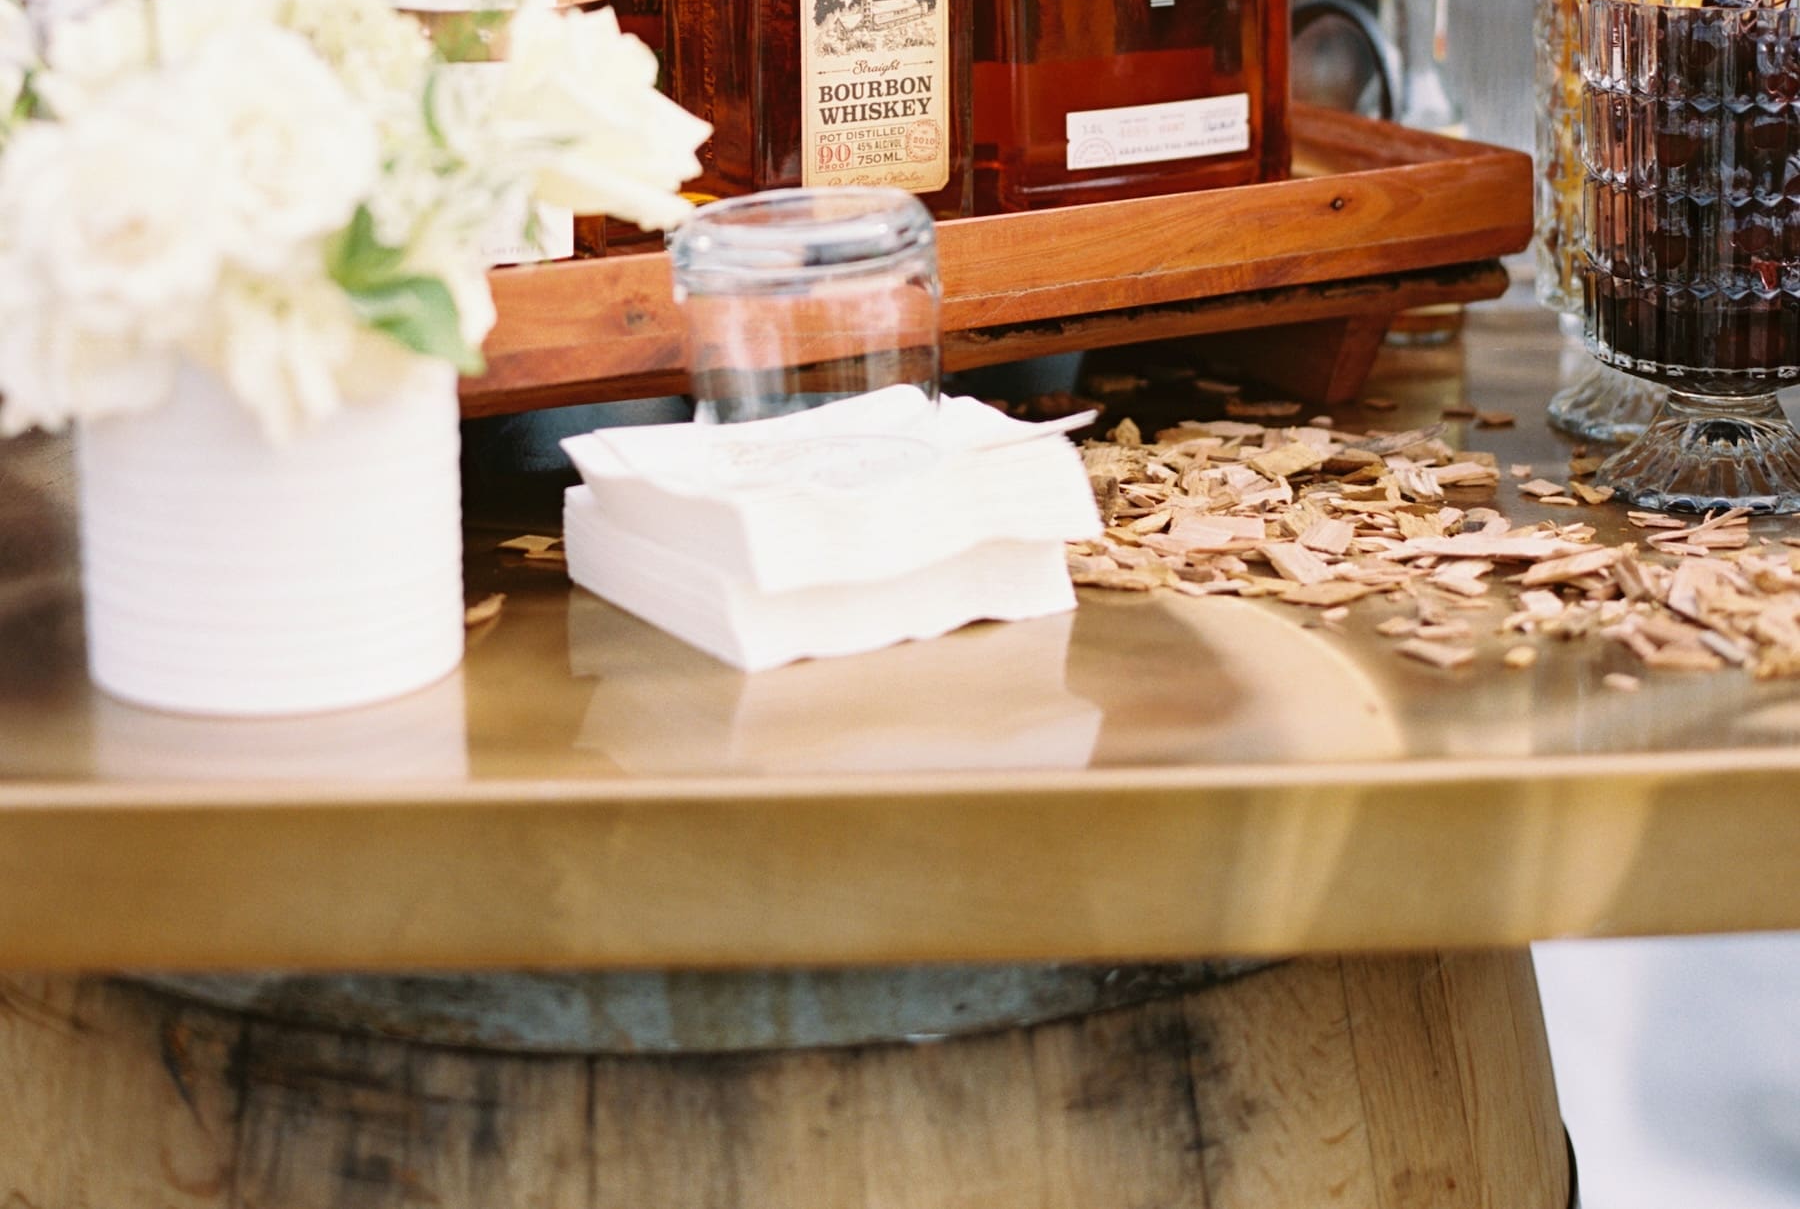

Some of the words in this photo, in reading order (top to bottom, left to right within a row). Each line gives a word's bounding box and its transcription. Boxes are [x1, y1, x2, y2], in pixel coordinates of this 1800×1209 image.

[852, 59, 901, 77] Straight
[818, 75, 933, 104] BOURBON
[819, 97, 933, 125] WHISKEY
[820, 132, 842, 144] POT
[846, 126, 906, 141] DISTILLED
[817, 143, 851, 165] 90
[819, 162, 851, 171] PROOF
